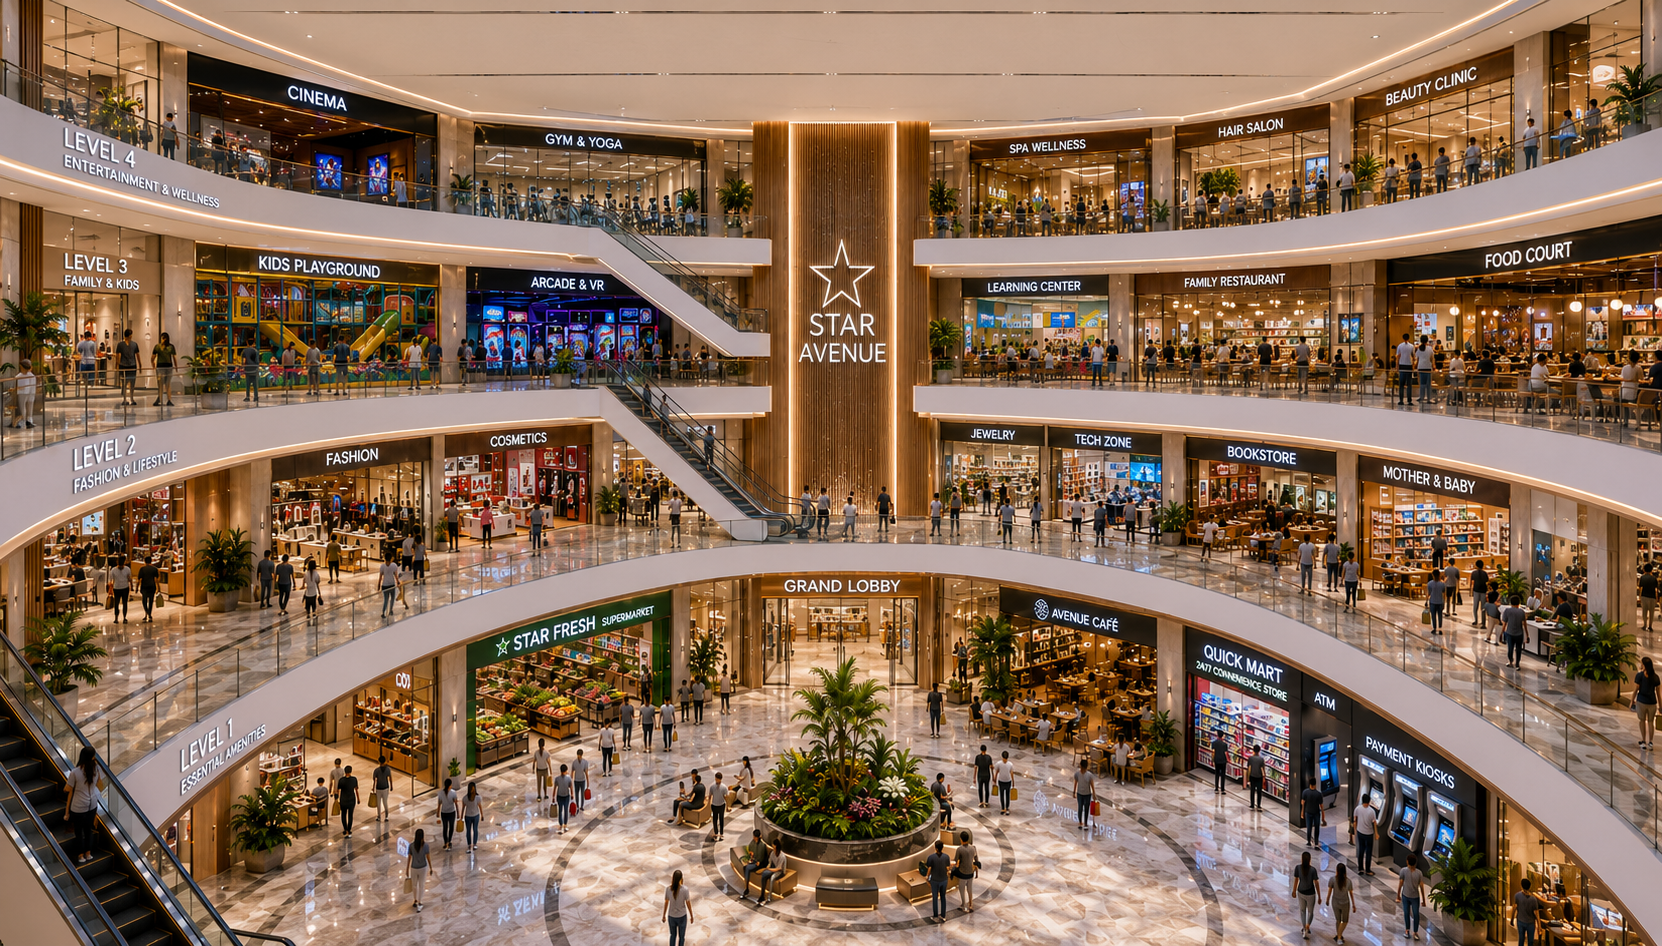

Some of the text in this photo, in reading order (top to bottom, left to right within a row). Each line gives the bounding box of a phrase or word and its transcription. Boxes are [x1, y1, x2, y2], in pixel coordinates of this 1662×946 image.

[1386, 66, 1478, 107] BEAUTY CLINIC
[288, 84, 347, 112] CINEMA
[1219, 118, 1284, 138] HAIR SALON
[64, 127, 136, 168] LEVEL 4
[546, 134, 622, 150] GYM & YOGA
[1009, 139, 1086, 154] SPA WELLNESS
[64, 154, 220, 209] ENTERTAINMENT & WELLNESS
[64, 253, 128, 273] LEVEL 3
[1485, 240, 1573, 269] FOOD COURT
[259, 255, 381, 279] KIDS PLAYGROUND
[64, 275, 140, 290] FAMILY & KIDS
[531, 277, 605, 291] ARCADE & VR
[988, 281, 1081, 293] LEARNING CENTER
[1185, 273, 1285, 288] FAMILY RESTAURANT
[810, 313, 875, 337] STAR
[799, 343, 886, 363] AVENUE
[490, 432, 547, 448] COSMETICS
[971, 428, 1016, 441] JEWELRY
[1075, 434, 1132, 449] TECH ZONE
[74, 434, 136, 471] LEVEL 2
[326, 447, 379, 466] FASHION
[1227, 445, 1297, 465] BOOKSTORE
[74, 450, 178, 494] FASHION & LIFESTYLE
[1382, 465, 1476, 494] MOTHER & BABY
[785, 579, 901, 593] GRAND LOBBY
[514, 606, 654, 650] STAR FRESH SUPERMARKET
[1052, 609, 1119, 632] AVENUE CAFÉ
[1203, 645, 1283, 683] QUICK MART
[1263, 685, 1287, 702] STORE
[1314, 692, 1336, 710] ATM
[180, 717, 233, 772] LEVEL 1
[180, 724, 266, 796] ESSENTIAL AMENITIES
[1365, 736, 1413, 769] PAYMENT
[1415, 759, 1455, 790] KIOSKS
